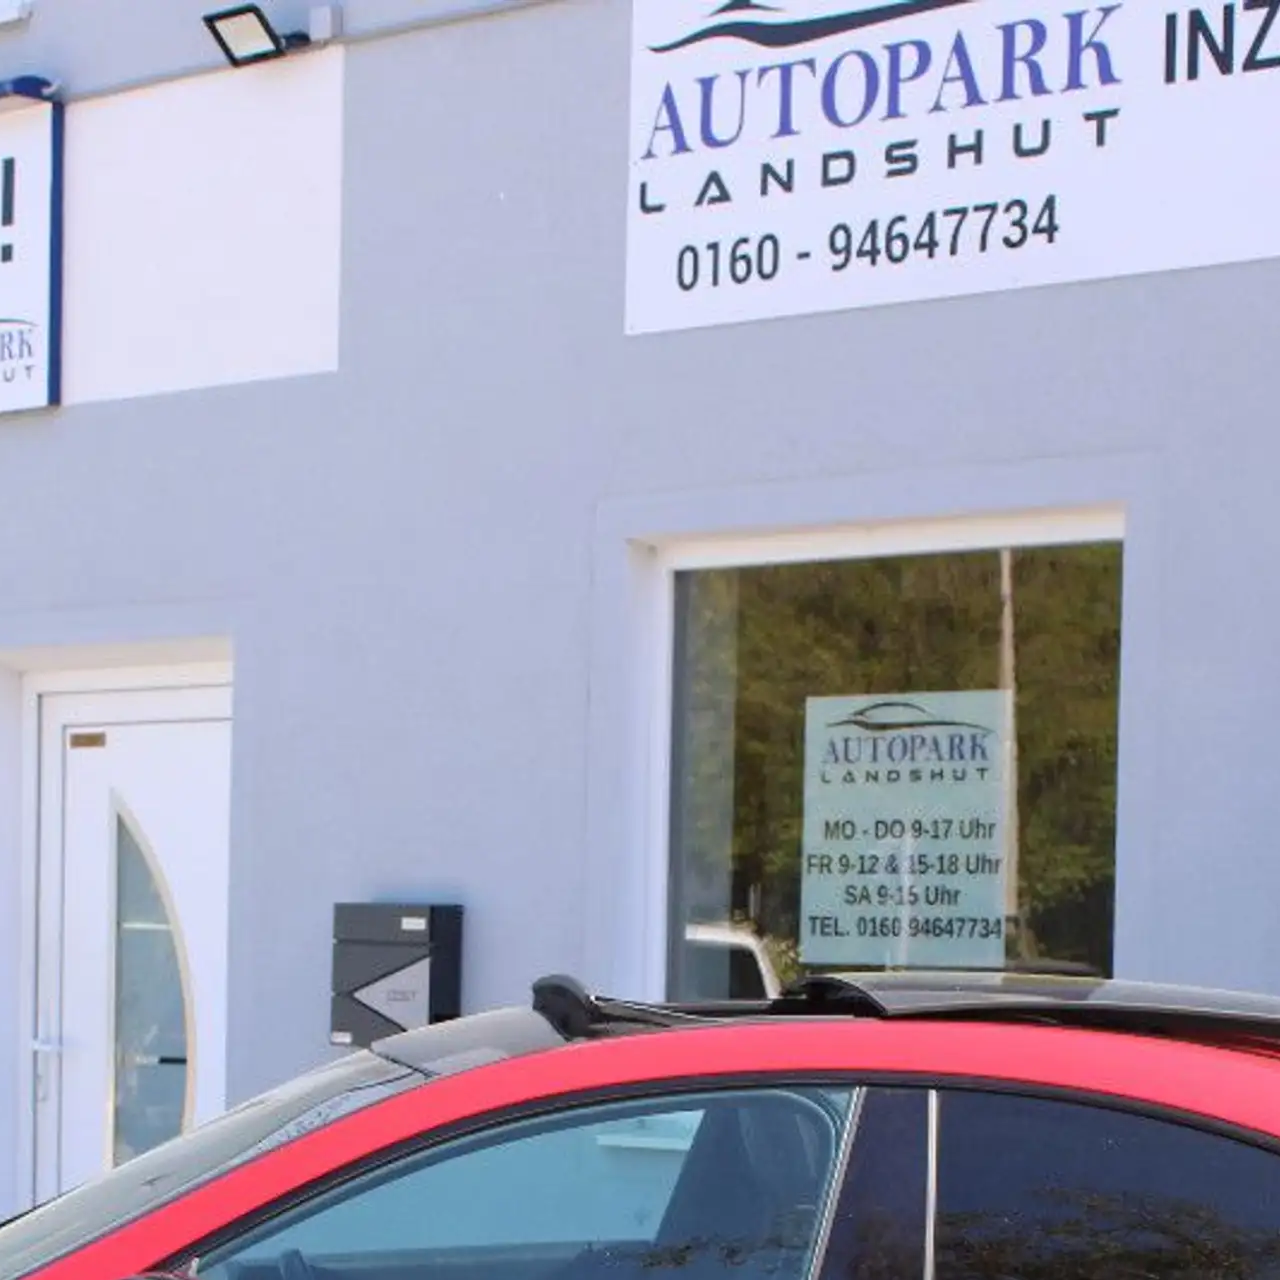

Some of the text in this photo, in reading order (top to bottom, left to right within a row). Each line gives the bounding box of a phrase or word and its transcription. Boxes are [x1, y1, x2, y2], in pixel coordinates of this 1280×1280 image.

[640, 4, 1124, 160] AUTOPARK
[639, 108, 1120, 214] LANDSHUT
[677, 233, 780, 291] 0160
[829, 194, 1059, 272] 94647734
[821, 731, 989, 765] AUTOPARK
[821, 767, 989, 784] LANDSHUT
[824, 820, 856, 841] MO
[874, 819, 906, 840] DO
[911, 819, 954, 840] 9-17
[959, 818, 997, 840] Uhr
[807, 854, 834, 875] FR
[838, 854, 879, 875] 9-12
[884, 854, 899, 875] &
[965, 853, 1004, 875] Uhr
[844, 884, 872, 905] SA
[924, 885, 962, 905] Uhr
[809, 916, 1003, 939] TEL. 0160 94647734
